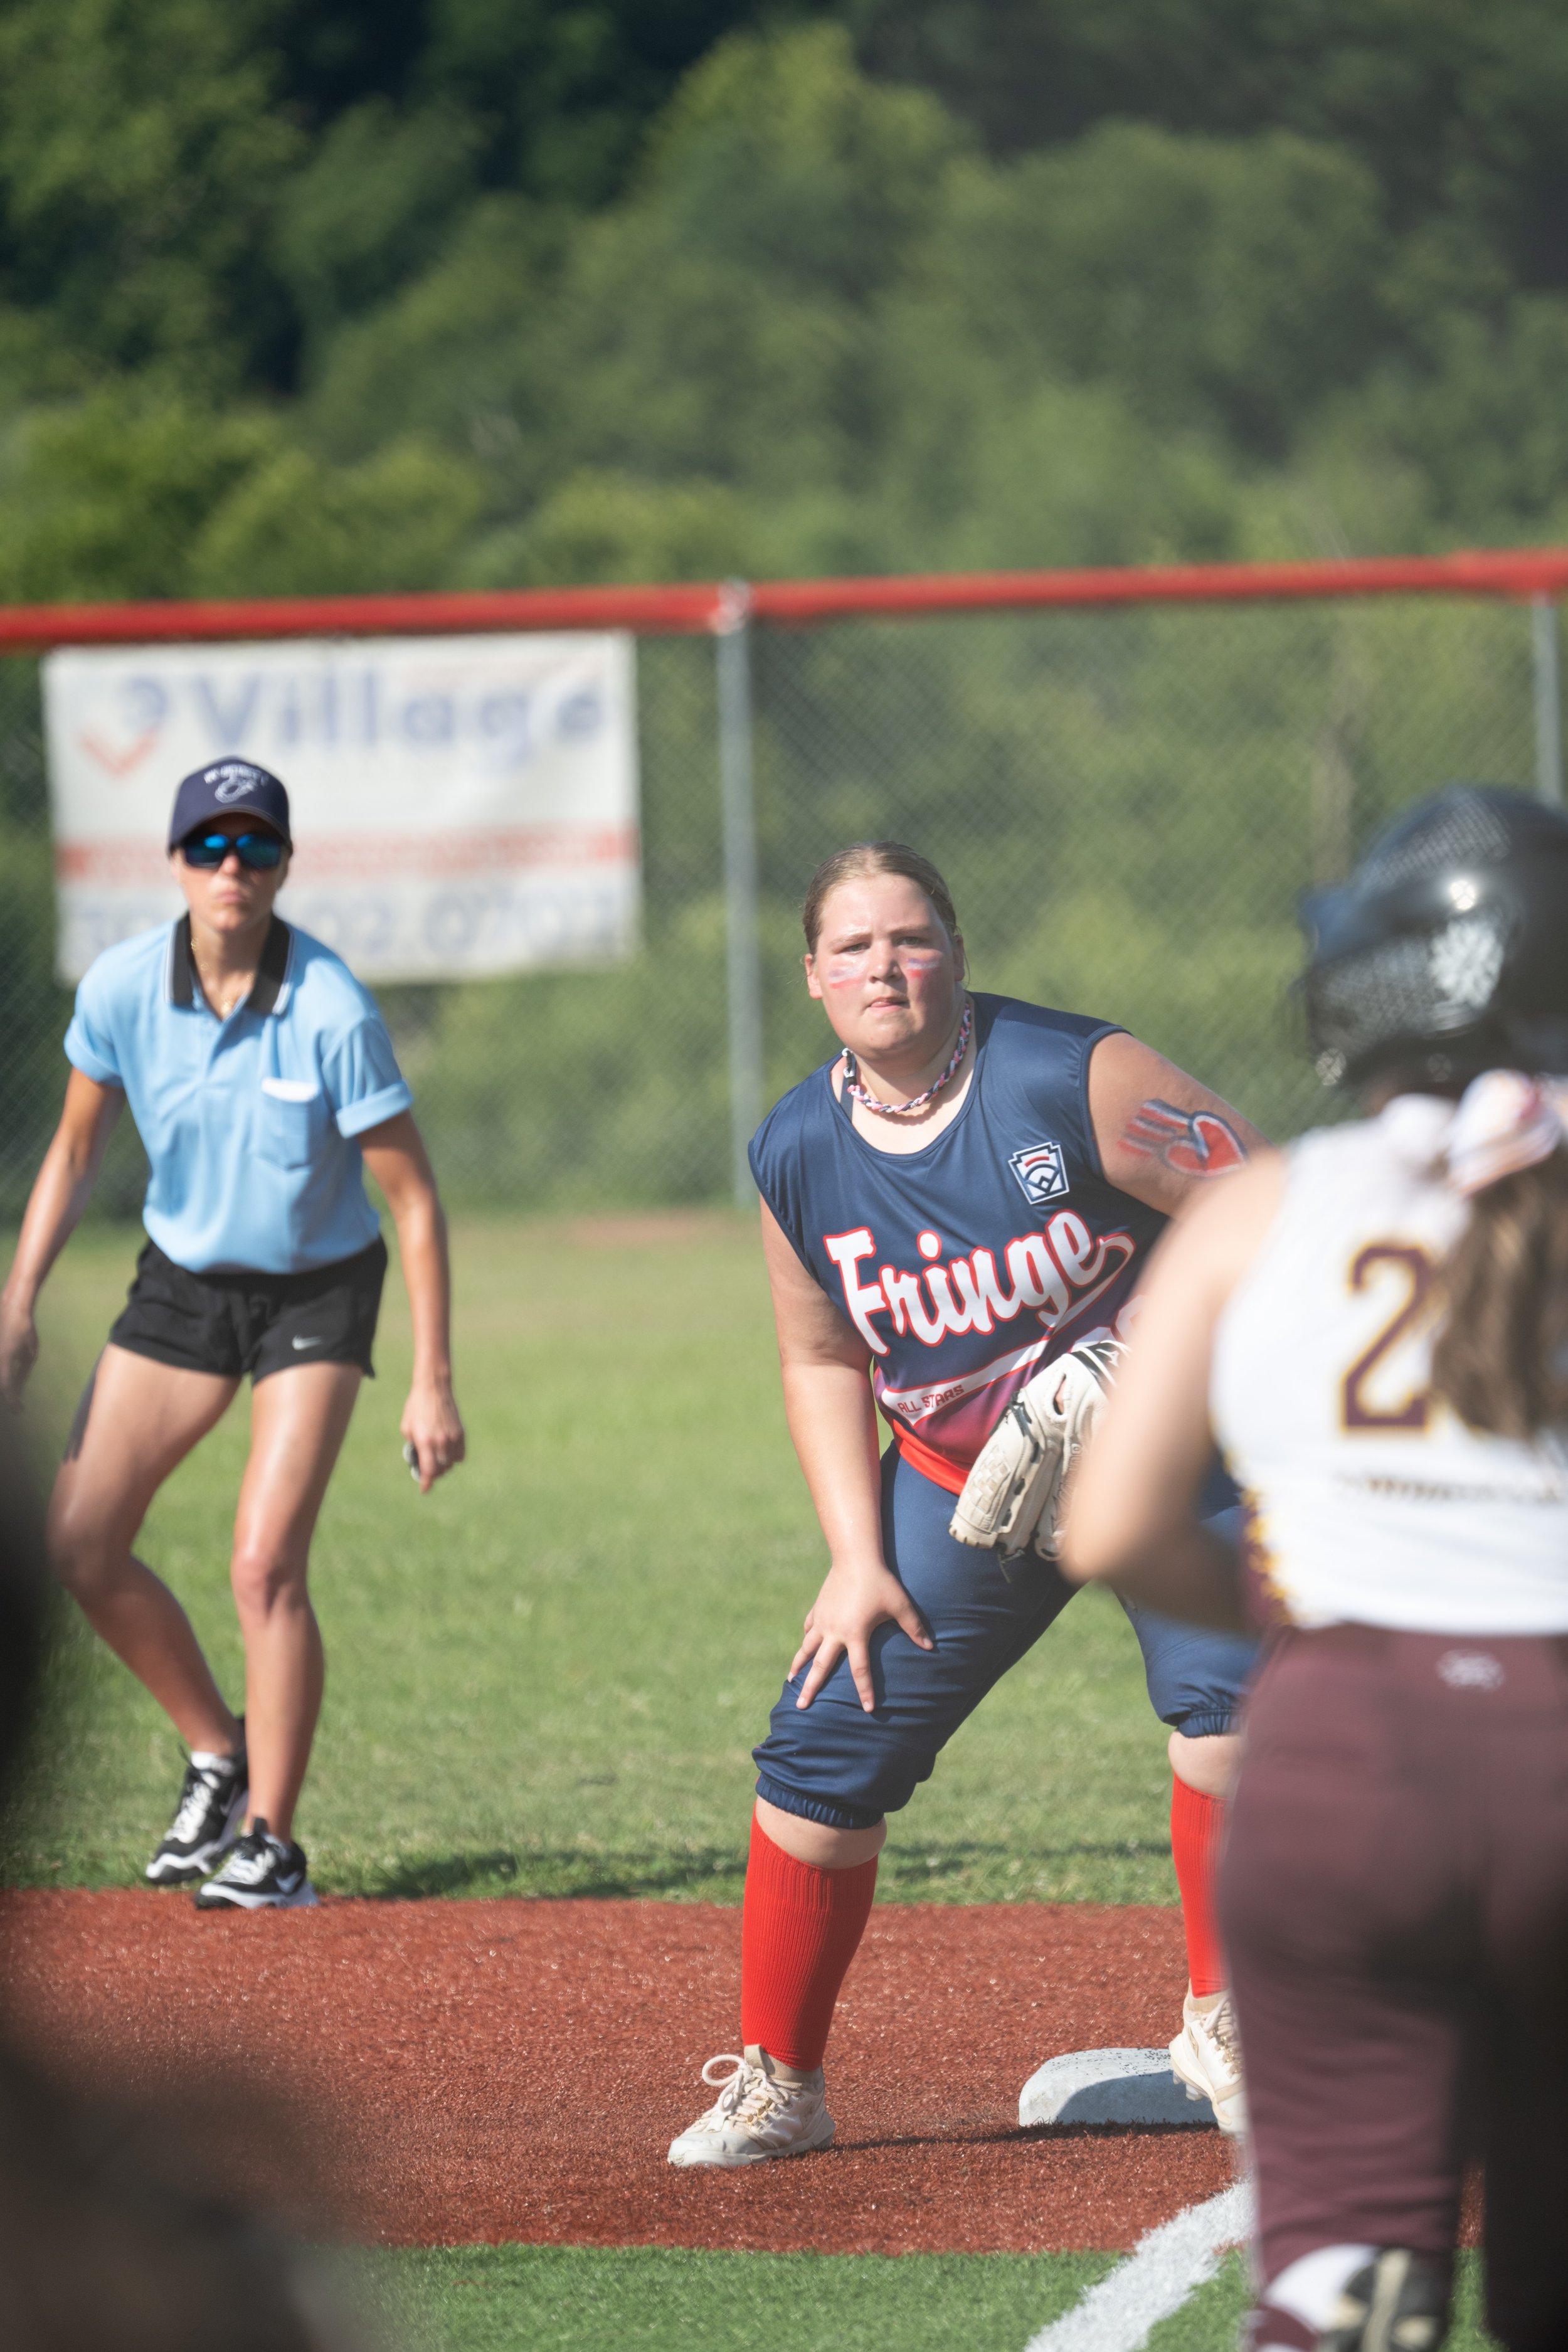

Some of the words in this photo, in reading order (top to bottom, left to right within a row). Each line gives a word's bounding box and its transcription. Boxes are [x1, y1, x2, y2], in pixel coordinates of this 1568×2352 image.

[824, 1210, 1113, 1355] Fringe
[897, 1401, 921, 1412] ALL
[921, 1384, 965, 1408] STARS
